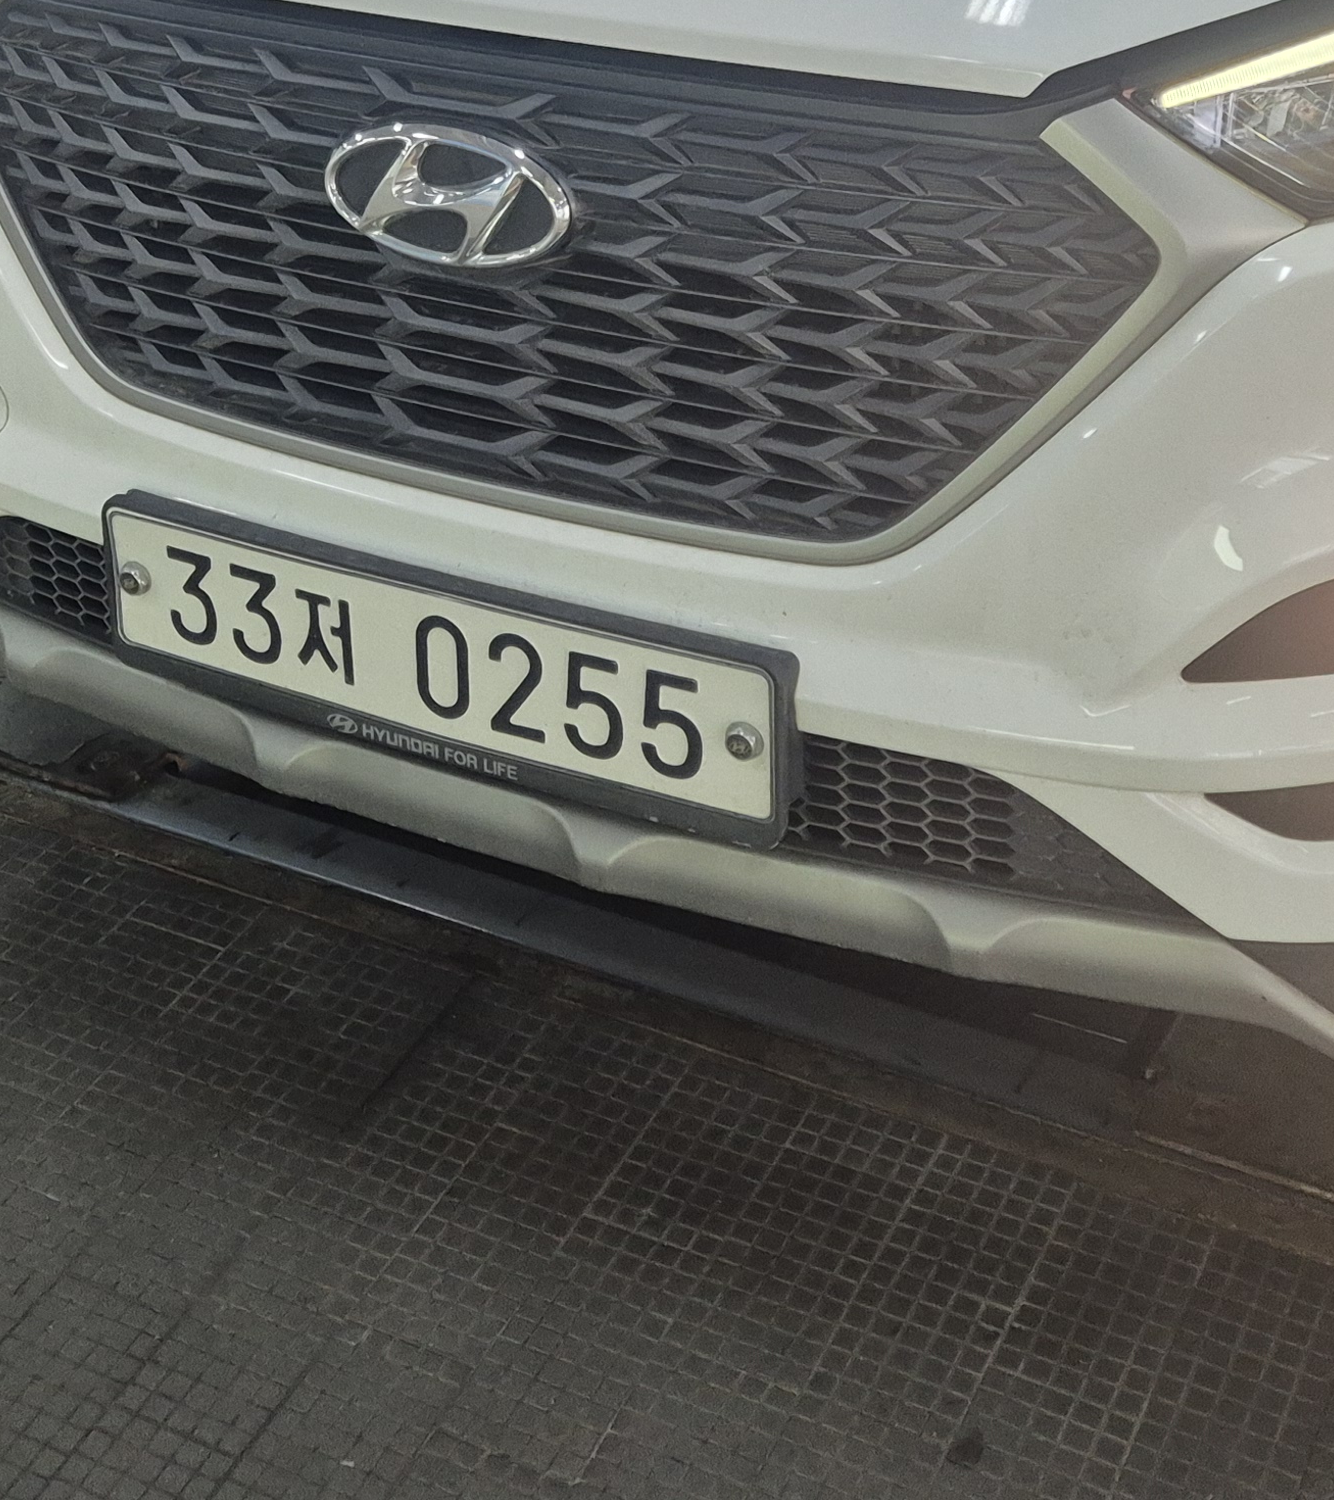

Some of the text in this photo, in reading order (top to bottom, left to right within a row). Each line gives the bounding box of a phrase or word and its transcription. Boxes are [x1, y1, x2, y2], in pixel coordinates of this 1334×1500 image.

[166, 545, 703, 780] 33저 0255
[362, 723, 518, 781] HYUNDAI FOR LIFE
